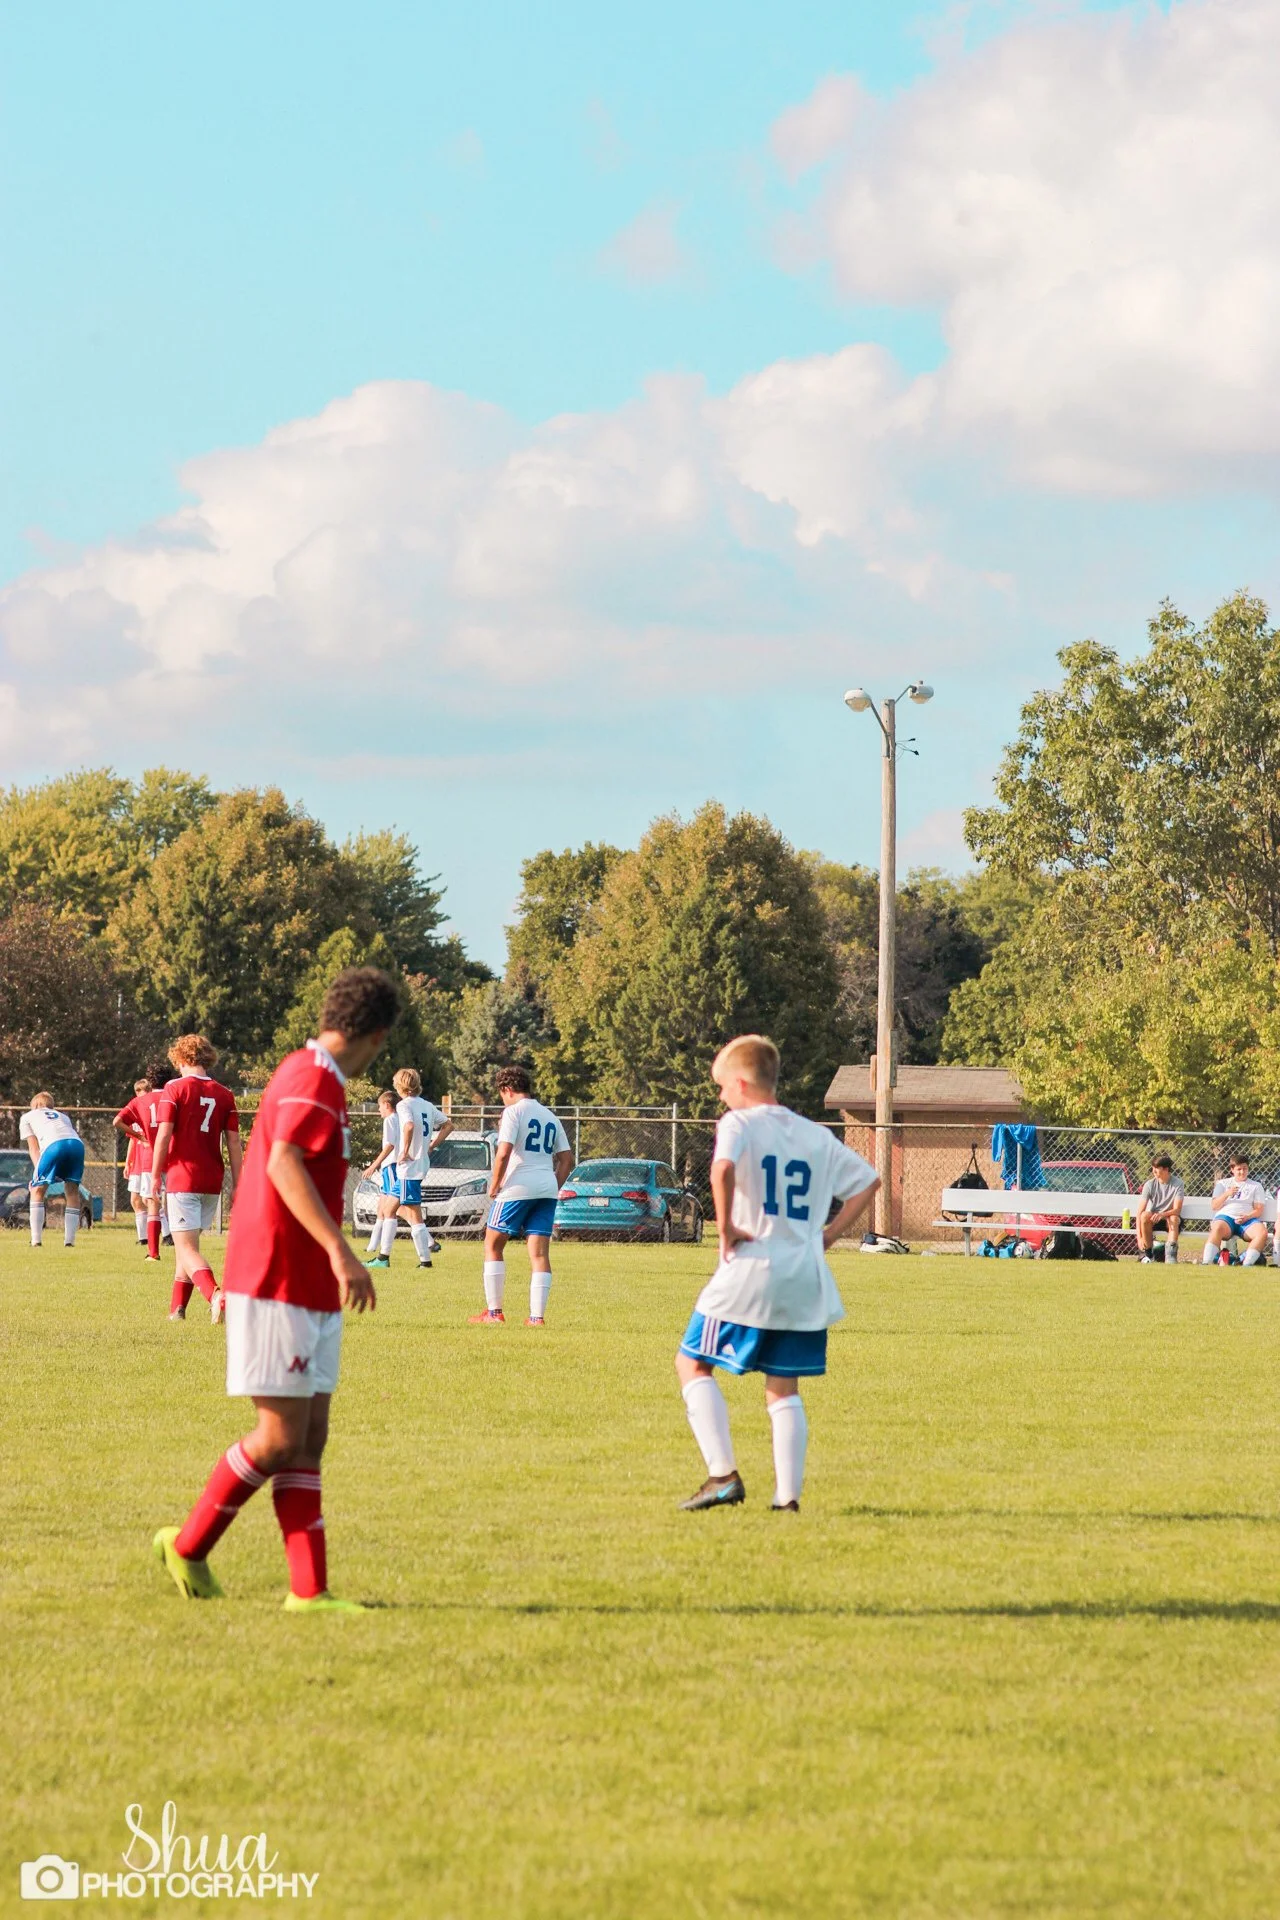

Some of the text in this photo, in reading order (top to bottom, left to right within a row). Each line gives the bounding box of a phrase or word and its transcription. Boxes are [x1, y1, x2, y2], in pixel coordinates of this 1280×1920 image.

[200, 1097, 216, 1133] 7
[421, 1113, 430, 1136] 5
[525, 1118, 557, 1155] 20
[761, 1154, 812, 1221] 12
